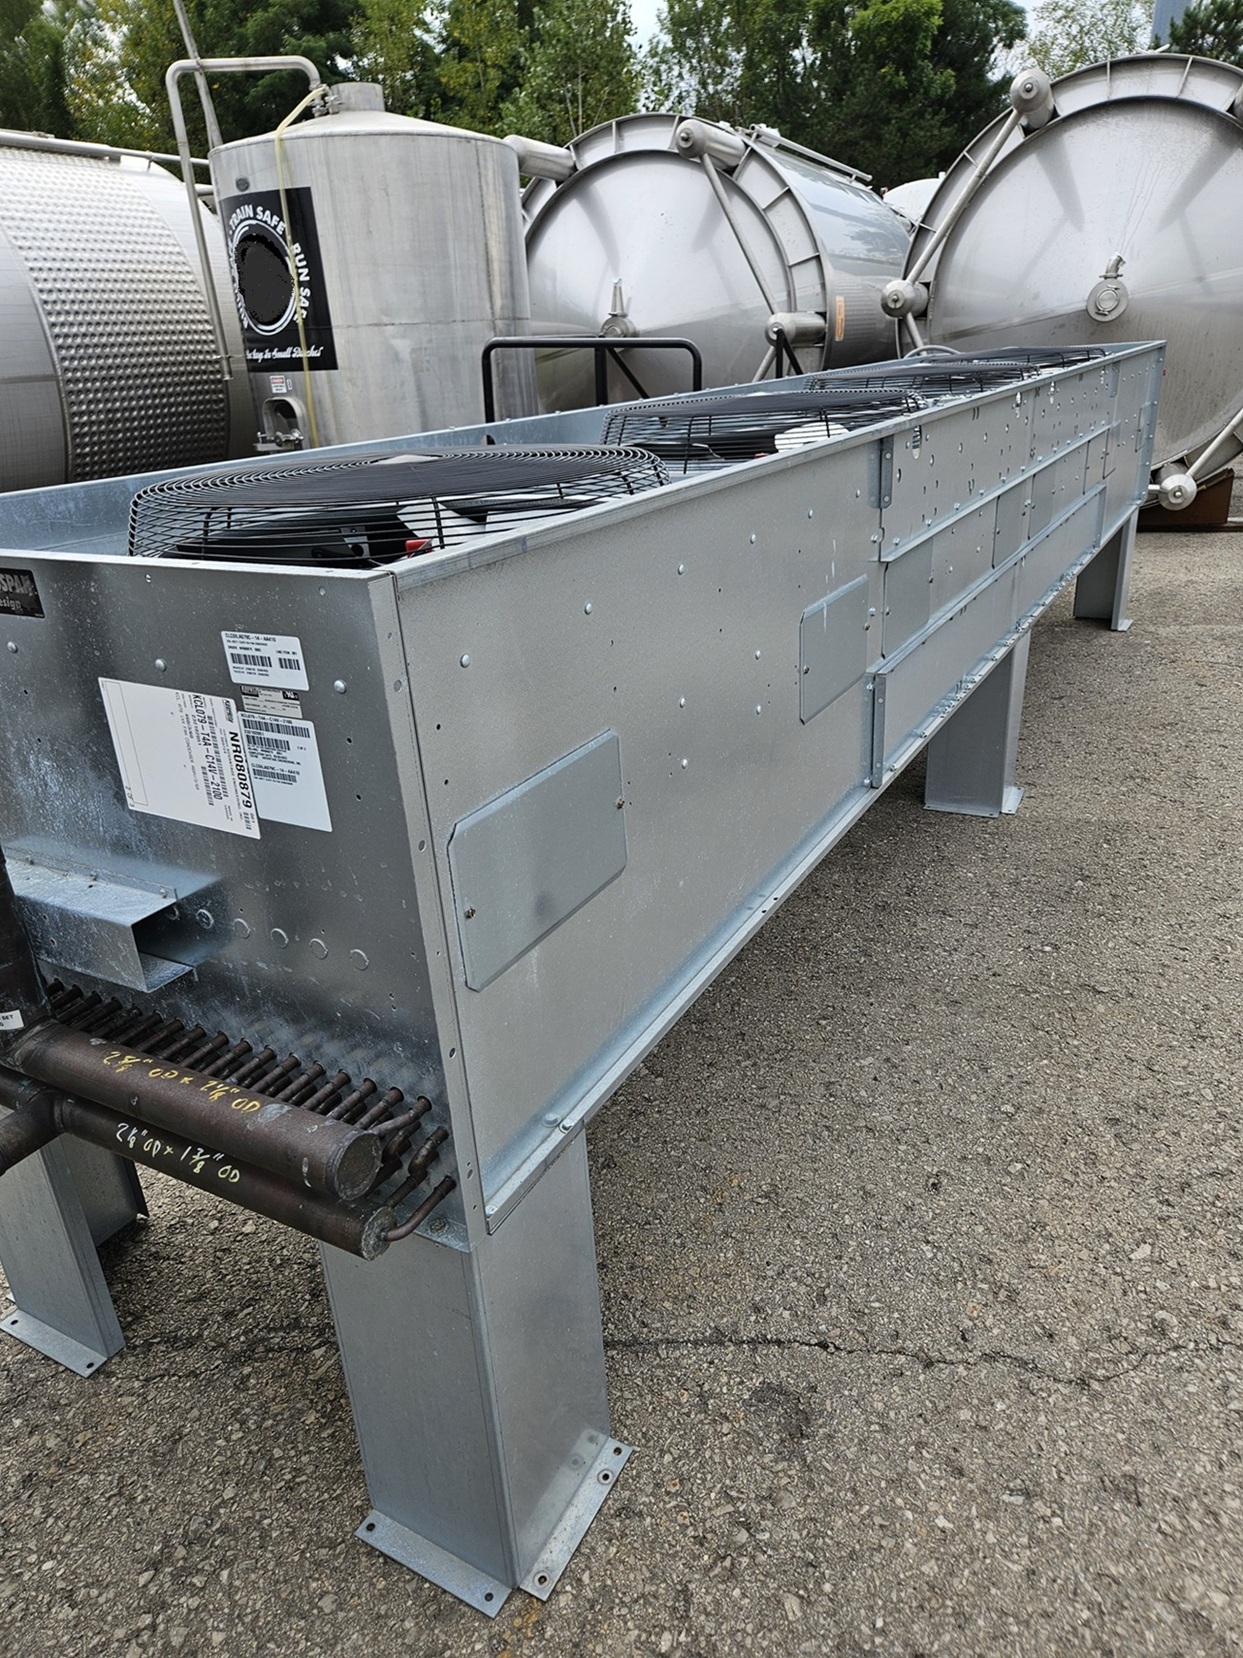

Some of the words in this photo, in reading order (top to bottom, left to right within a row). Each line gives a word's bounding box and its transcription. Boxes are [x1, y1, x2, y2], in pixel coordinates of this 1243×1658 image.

[256, 206, 287, 235] SAFE
[292, 344, 324, 358] Baches
[228, 731, 252, 809] NR080879
[217, 1165, 240, 1182] OD
